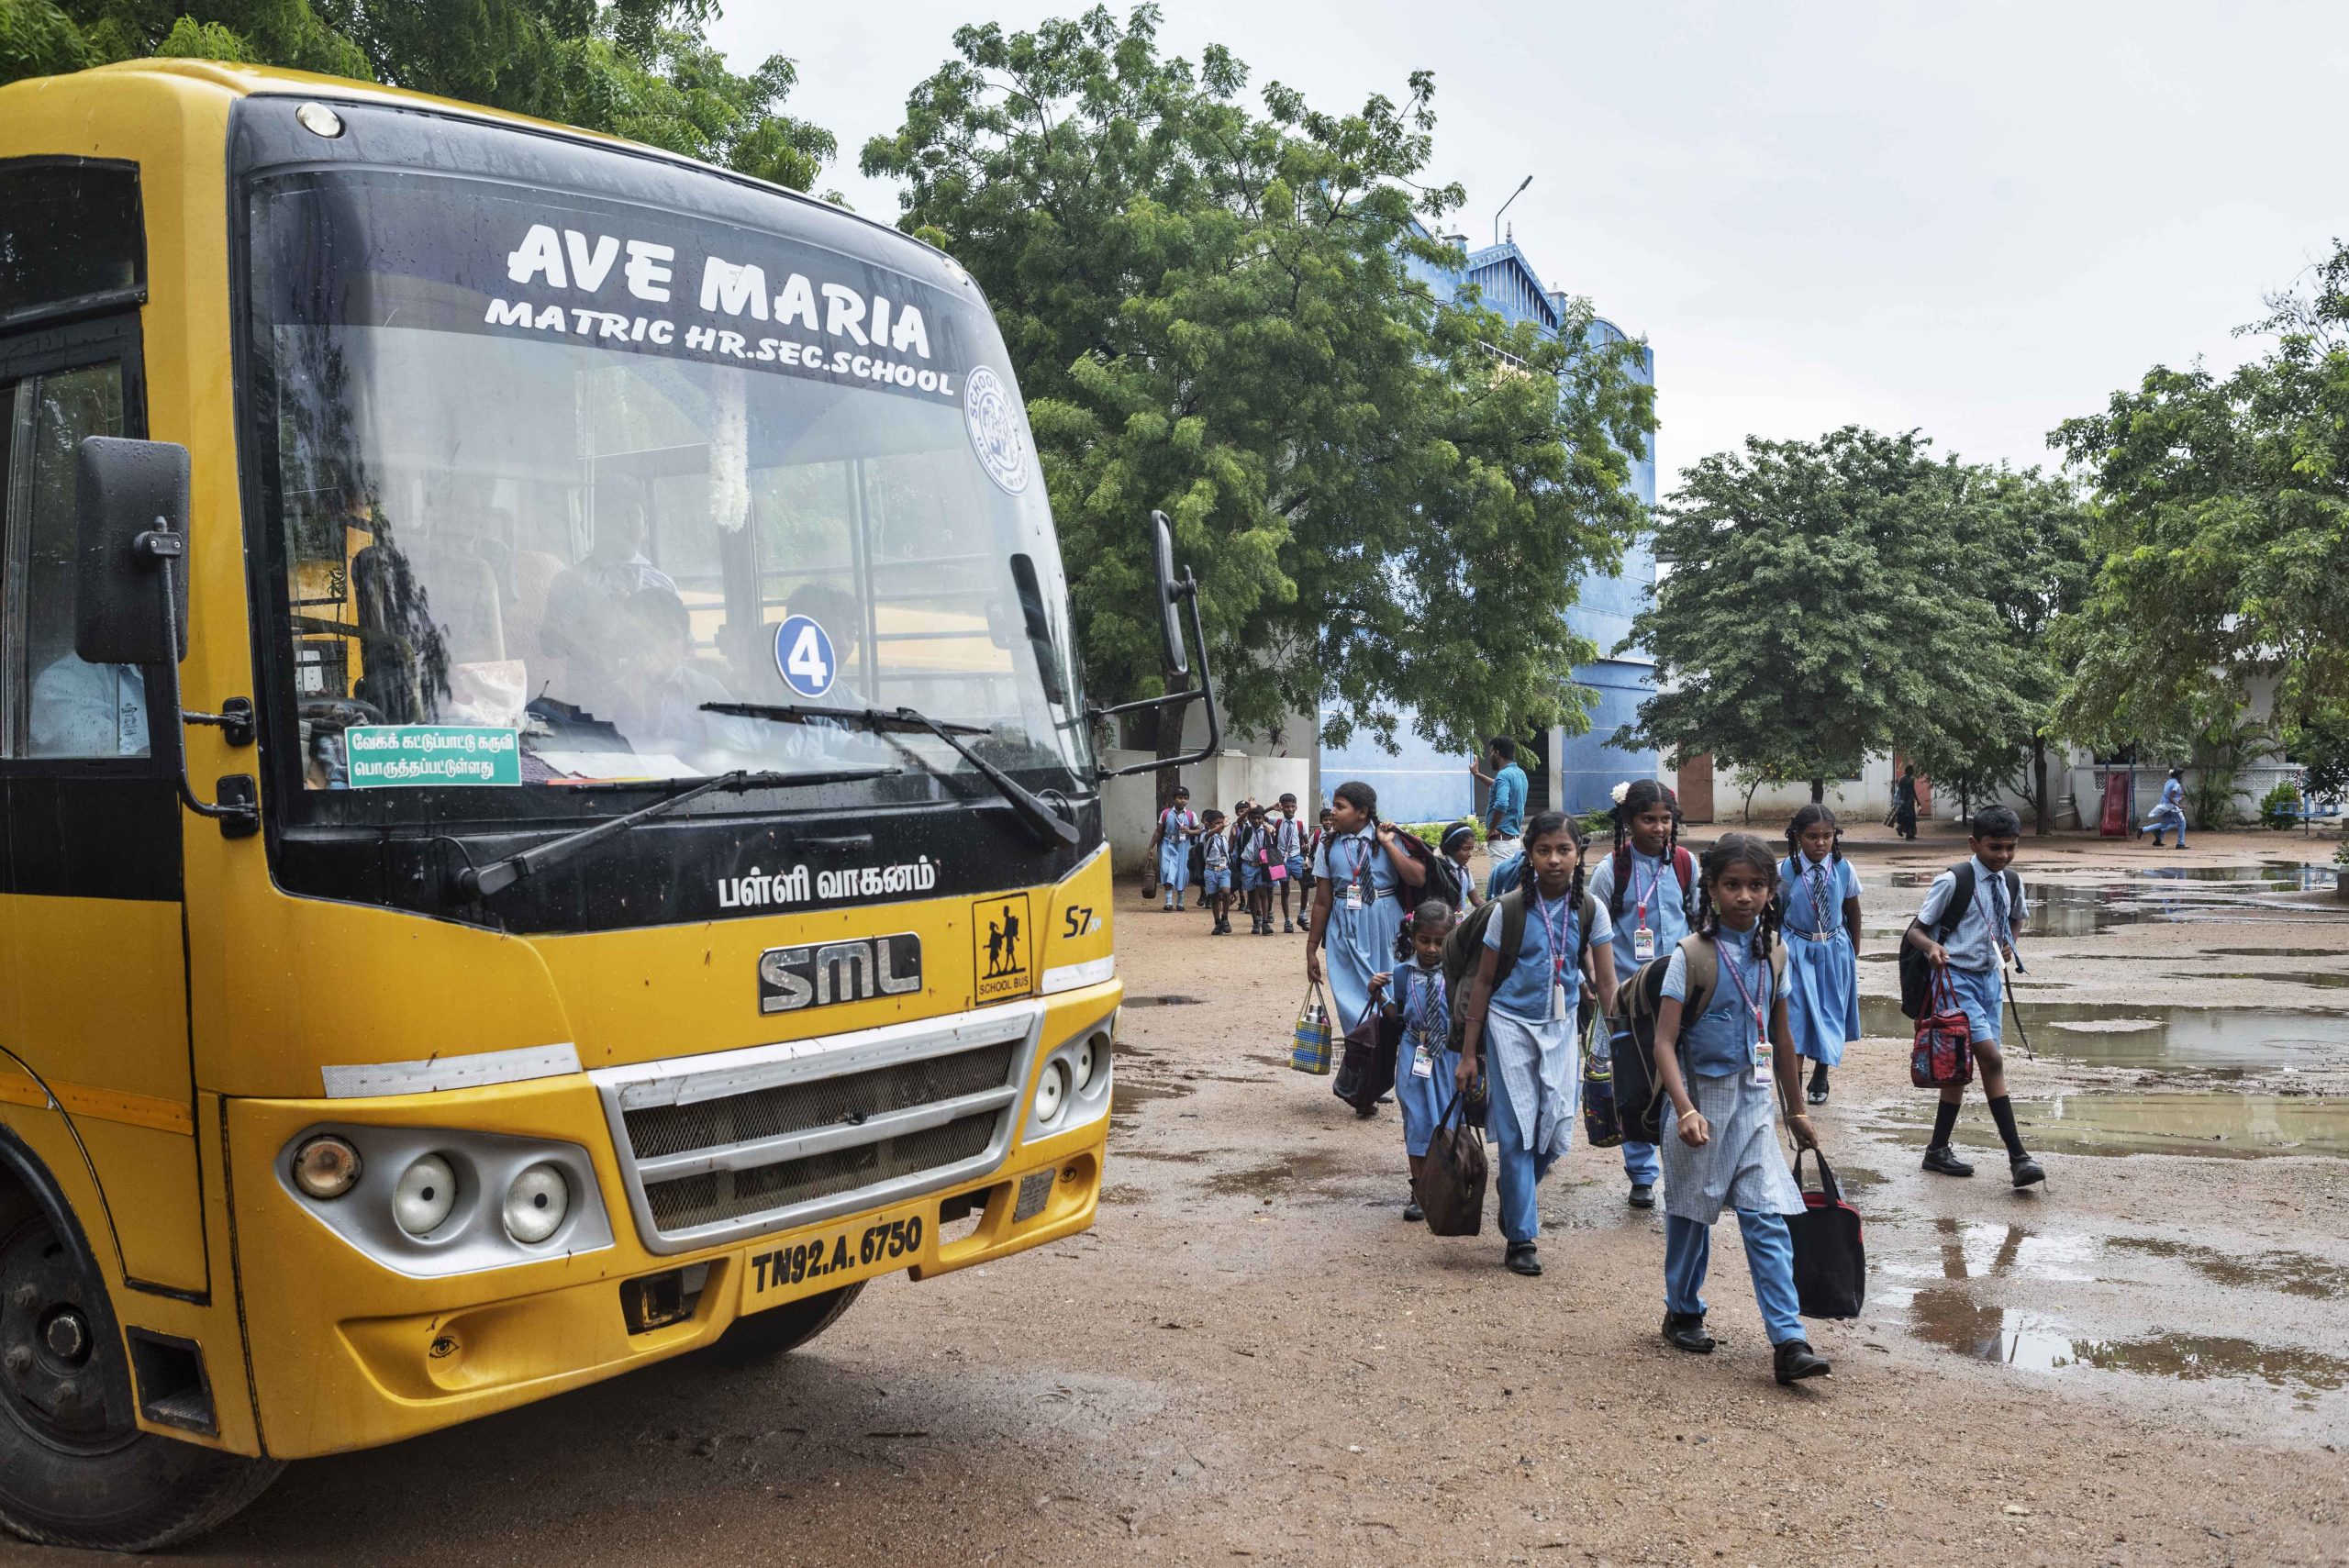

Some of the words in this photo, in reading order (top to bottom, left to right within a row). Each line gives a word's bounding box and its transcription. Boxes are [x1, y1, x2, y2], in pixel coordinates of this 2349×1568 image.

[507, 224, 674, 303] AVE
[699, 256, 930, 359] MARIA
[484, 298, 674, 345] MATRIC
[685, 325, 954, 396] HR.SEC.SCHOOL
[969, 374, 1000, 419] SCHOOL
[787, 625, 828, 687] 4
[352, 733, 399, 751] வேகக்
[403, 732, 475, 752] கட்டுப்பாட்டு
[479, 733, 515, 752] கருவி
[354, 758, 495, 779] பொருத்தப்பட்டுள்ளது
[718, 864, 810, 907] பள்ளி
[817, 854, 935, 899] வாகனம்
[1063, 905, 1093, 939] S7
[760, 940, 918, 1012] SML
[979, 979, 1012, 995] SCHOOL
[1014, 975, 1029, 988] BUS
[751, 1235, 855, 1293] TN92.A.
[860, 1216, 923, 1265] 6750
